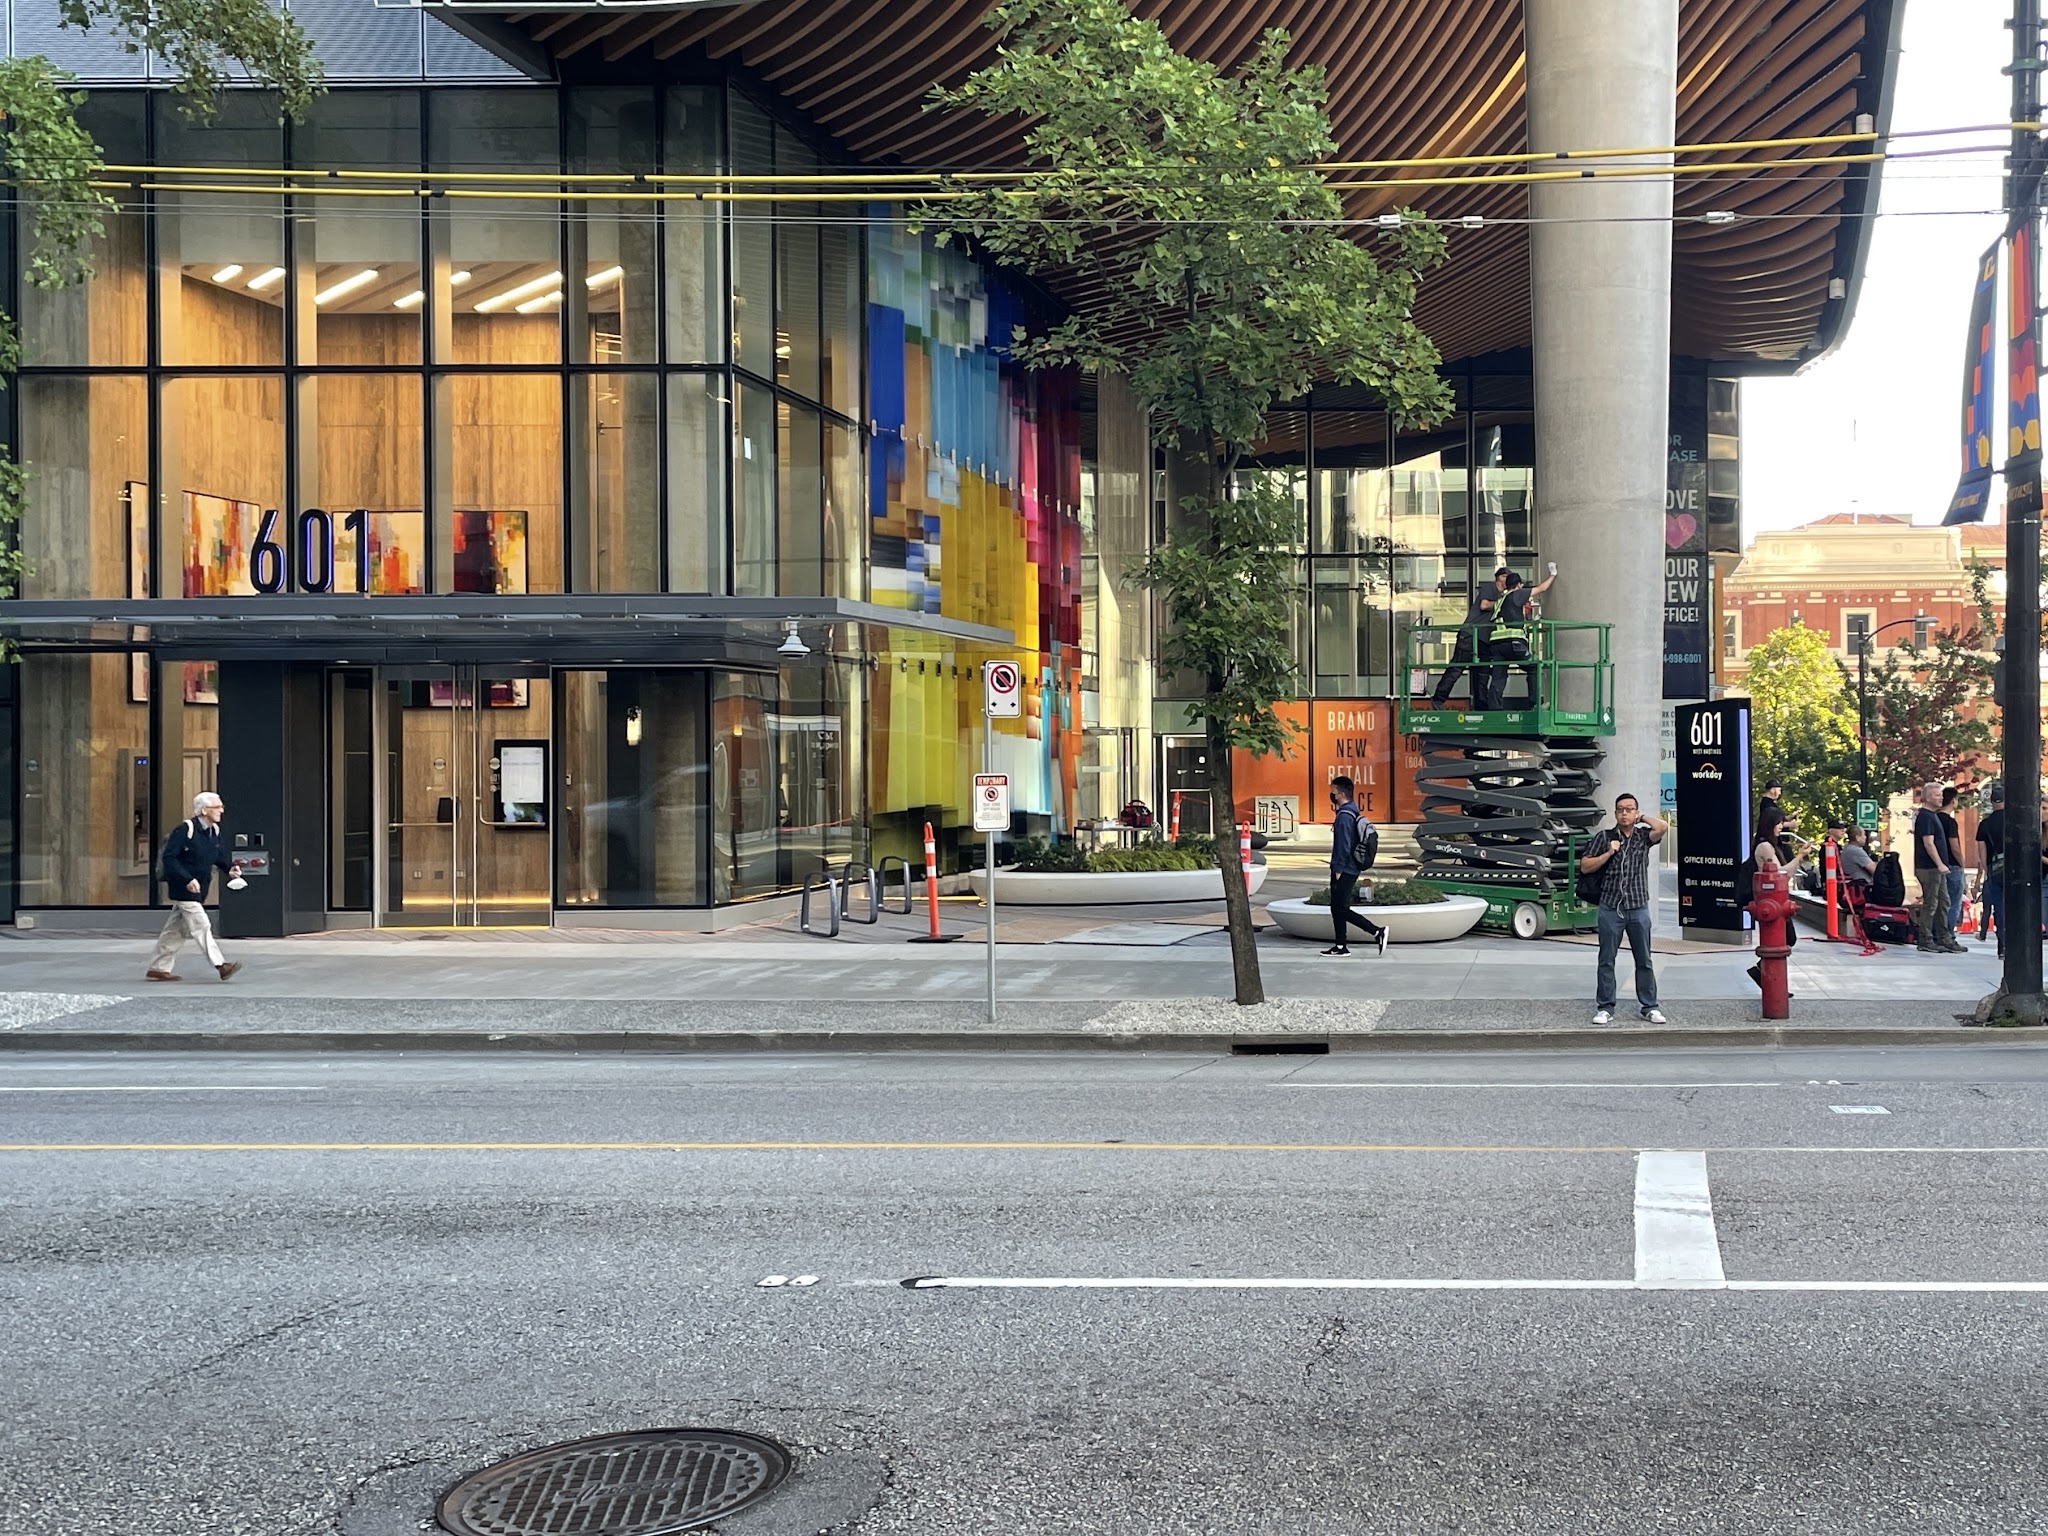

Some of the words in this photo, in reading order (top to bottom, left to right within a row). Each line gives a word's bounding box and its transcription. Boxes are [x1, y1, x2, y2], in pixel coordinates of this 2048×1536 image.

[1669, 450, 1698, 462] ASE
[1666, 490, 1698, 510] OVE
[250, 509, 369, 594] 601
[1666, 558, 1698, 578] OUR
[1666, 580, 1699, 602] EW
[1664, 607, 1698, 622] FFICE!
[1664, 654, 1702, 664] 4-998-6001
[1328, 711, 1375, 731] BRAND
[1410, 714, 1440, 724] SKYJACK
[1691, 712, 1722, 745] 601
[1336, 738, 1367, 758] NEW
[1692, 770, 1722, 780] workday
[1861, 803, 1874, 818] P
[1435, 844, 1462, 854] SKYJACK
[1684, 856, 1704, 864] OFFICE
